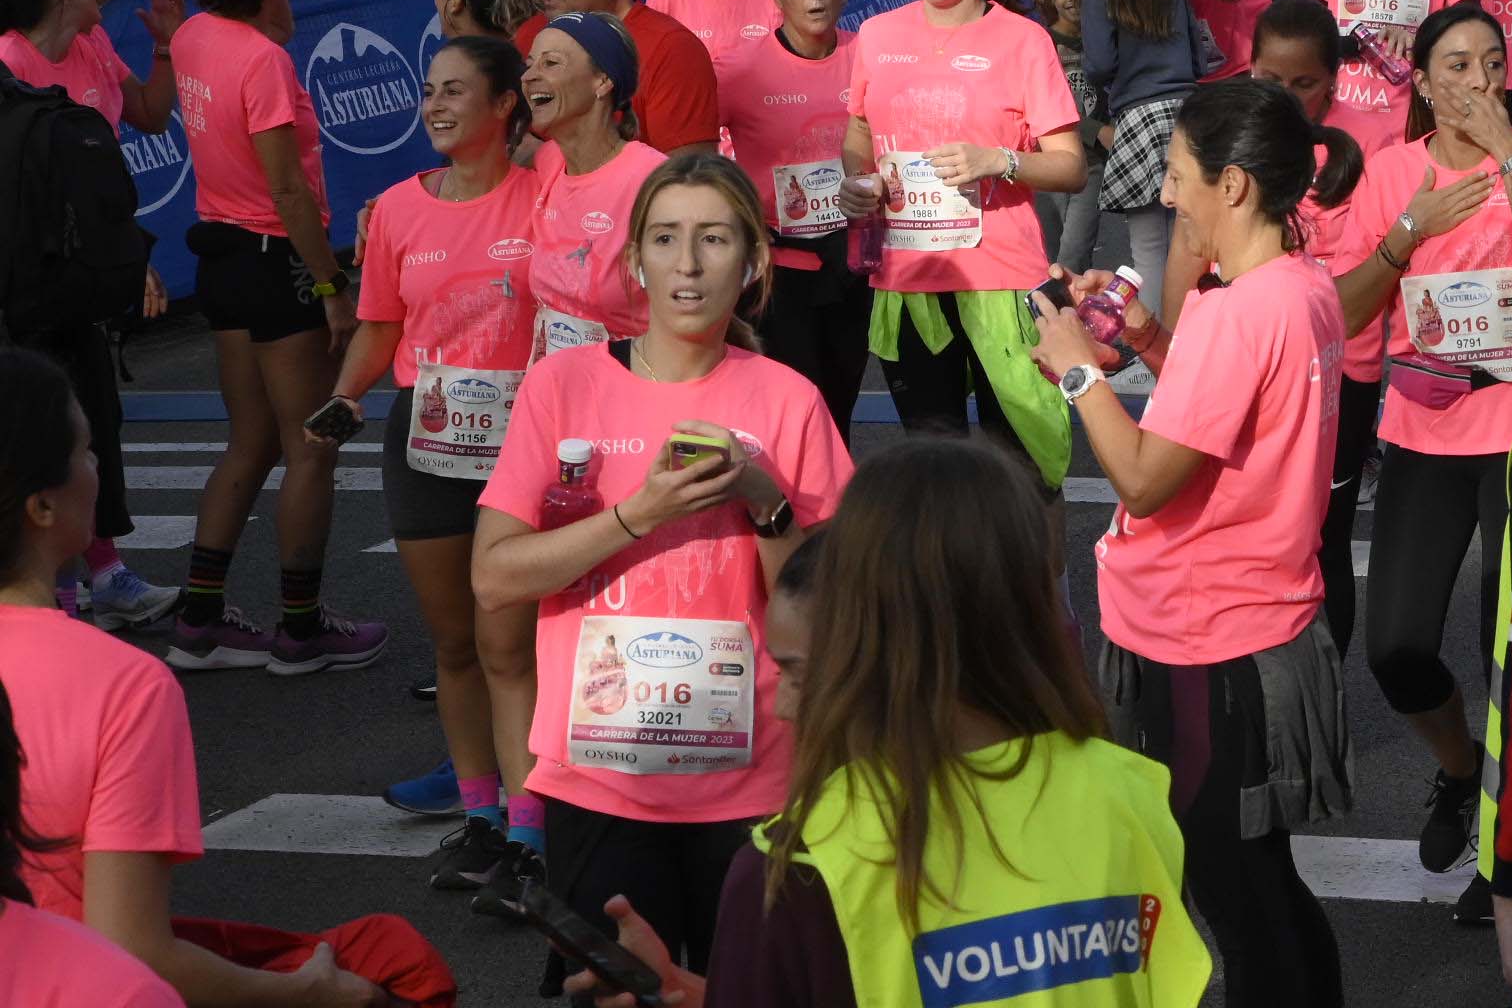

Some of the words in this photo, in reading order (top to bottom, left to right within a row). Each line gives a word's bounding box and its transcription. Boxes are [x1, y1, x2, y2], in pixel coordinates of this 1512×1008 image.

[764, 94, 807, 105] OYSHO
[1336, 82, 1389, 107] UMA
[314, 78, 416, 129] ASTURIANA
[810, 195, 840, 211] 016
[908, 191, 942, 205] 016
[815, 211, 841, 223] 14412
[912, 209, 938, 218] 19881
[490, 244, 532, 256] ASTURIANA
[1447, 315, 1489, 334] 016
[1456, 337, 1482, 349] 9791
[451, 385, 496, 399] ASTURIANA
[451, 411, 493, 429] 016
[453, 432, 487, 444] 31156
[423, 441, 454, 453] CARRERA
[456, 446, 466, 454] DE
[590, 437, 645, 454] YSHO
[417, 456, 454, 470] OYSHO
[709, 641, 743, 653] SUMA
[633, 680, 692, 705] 016
[637, 710, 683, 726] 32021
[589, 728, 637, 740] CARRERA
[640, 732, 655, 741] DE
[656, 732, 669, 742] LA
[677, 733, 707, 743] MUJER
[710, 734, 734, 744] 2023
[584, 748, 638, 764] OYSHO
[681, 754, 737, 765] Santander
[923, 918, 1139, 990] VOLUNTARIS
